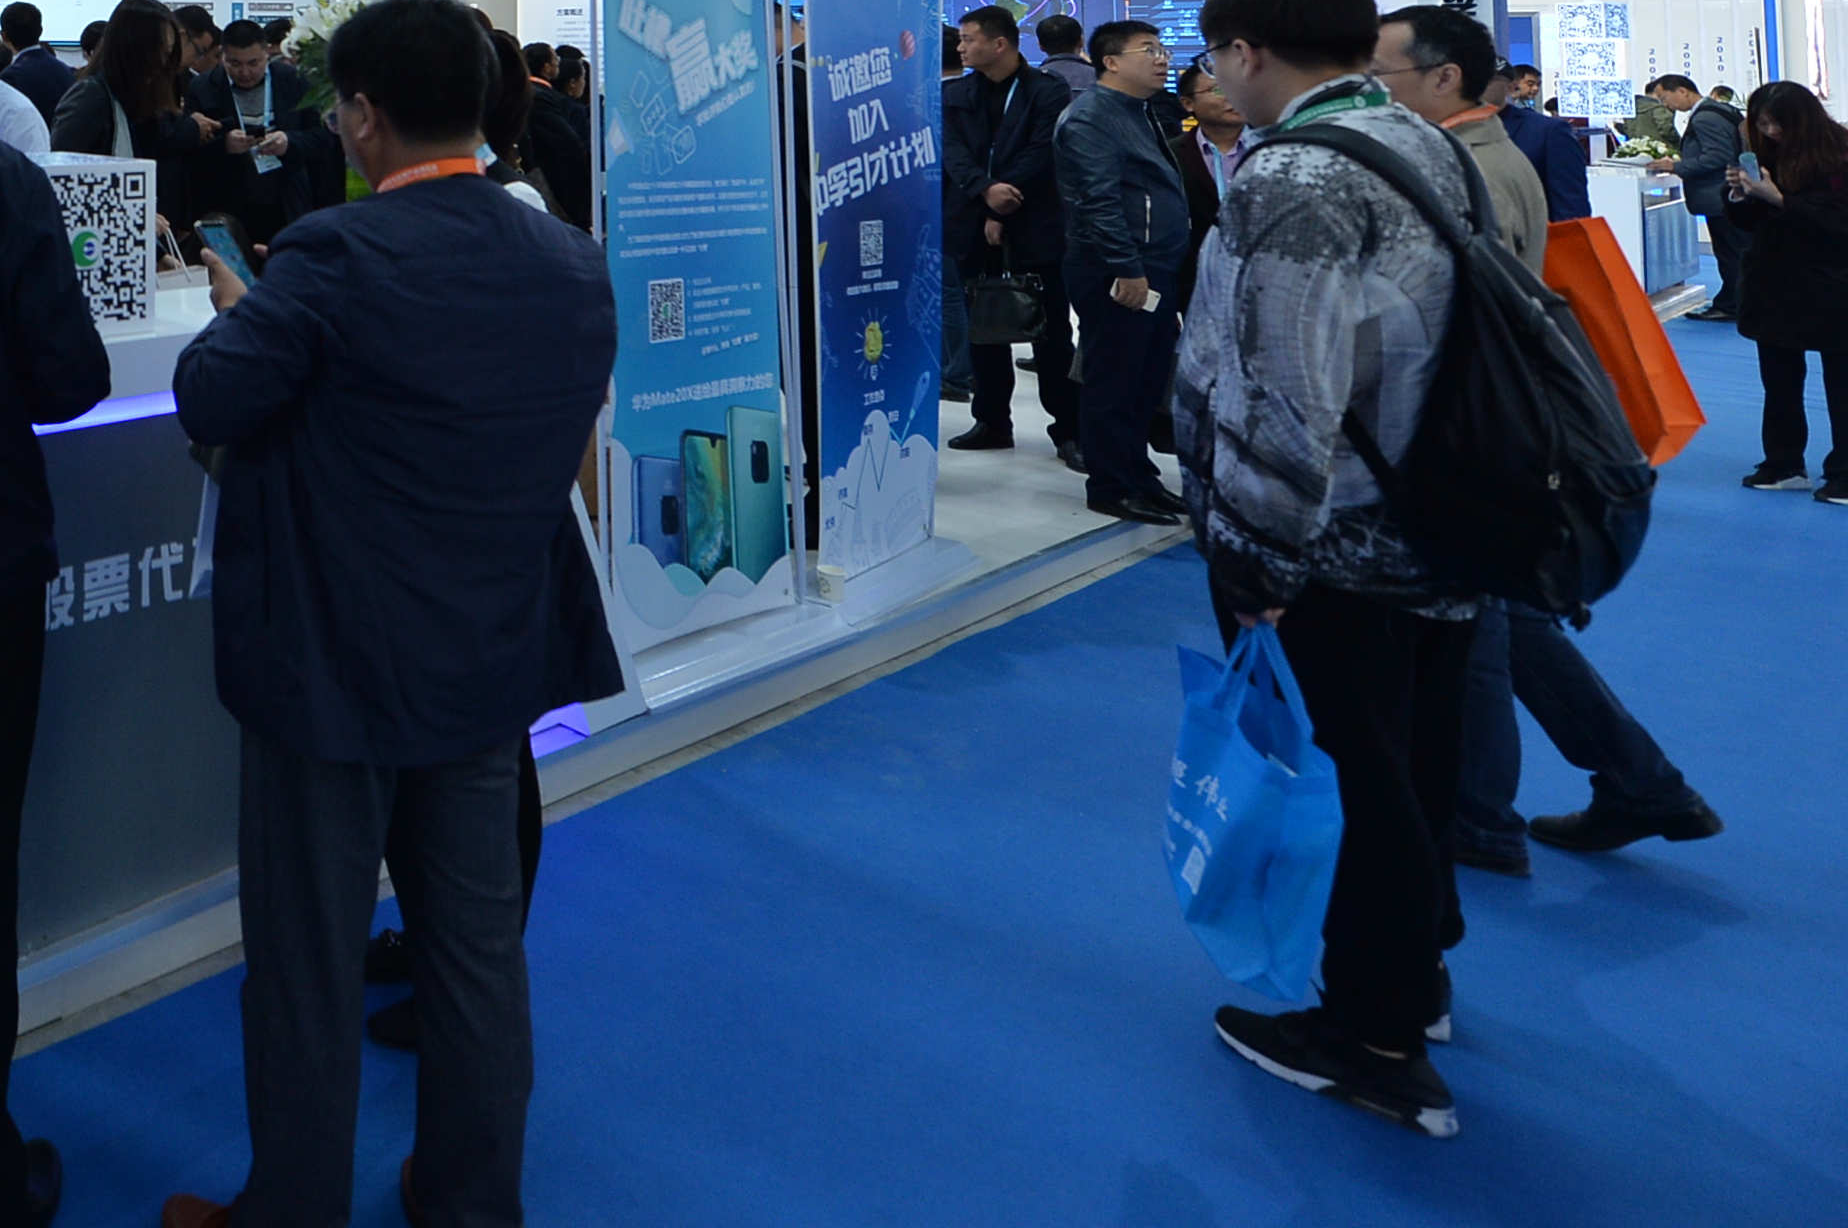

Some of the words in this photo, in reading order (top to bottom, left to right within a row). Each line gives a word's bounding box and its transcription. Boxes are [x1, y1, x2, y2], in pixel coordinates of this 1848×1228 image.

[828, 46, 893, 102] 诚邀您
[1648, 48, 1656, 81] 200
[1717, 36, 1725, 71] 2010
[848, 98, 890, 145] 加入
[45, 538, 198, 632] 股票代
